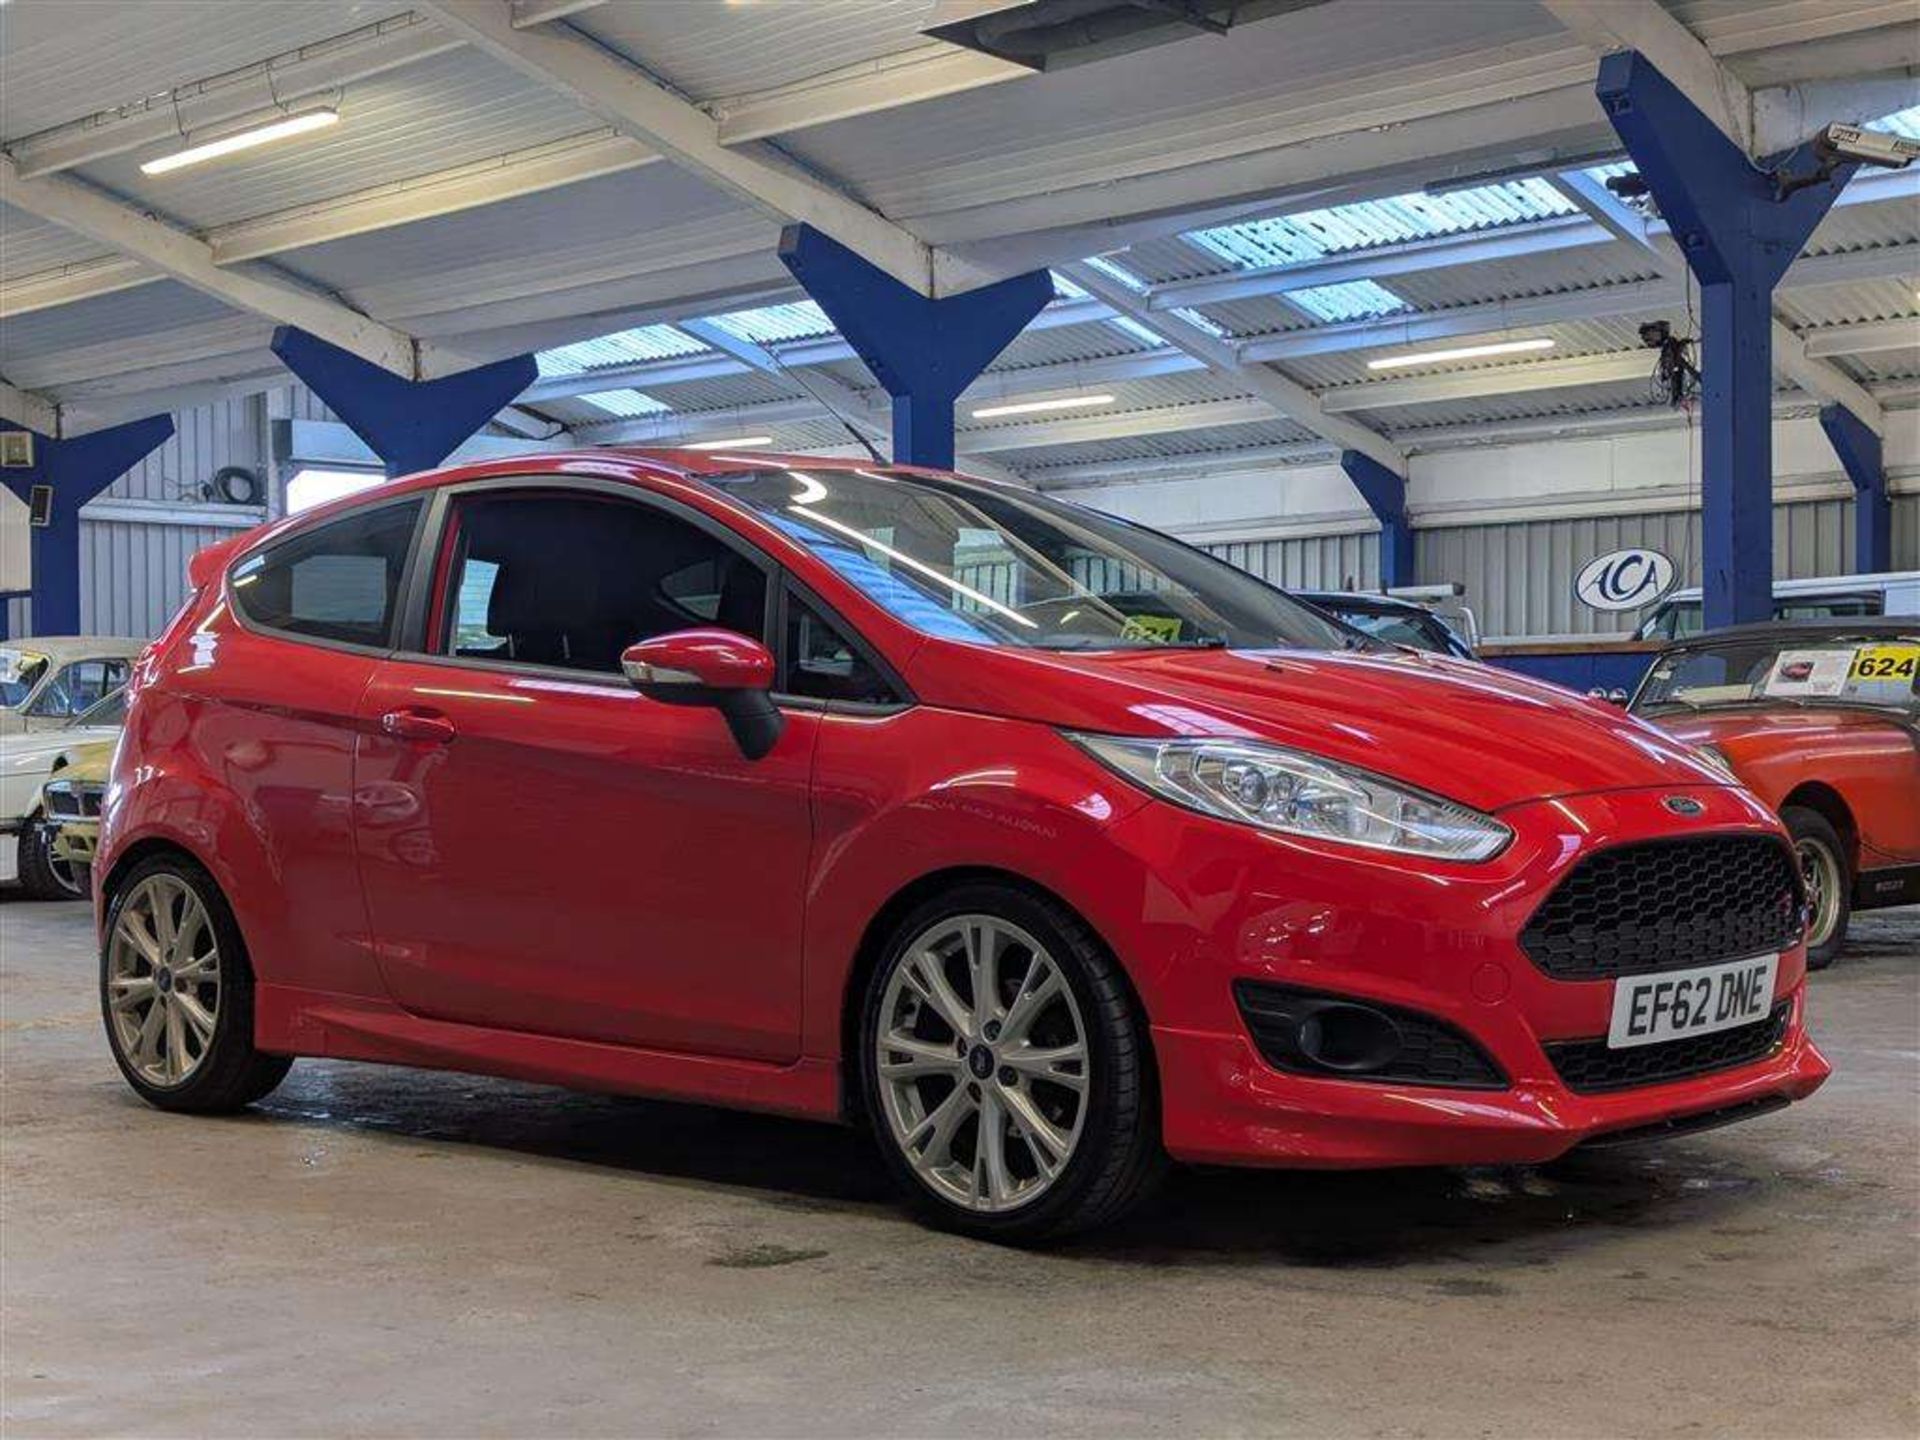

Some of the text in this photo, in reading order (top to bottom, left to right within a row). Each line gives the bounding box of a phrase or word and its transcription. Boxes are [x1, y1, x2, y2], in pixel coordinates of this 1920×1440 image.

[1581, 554, 1658, 601] ACA
[1858, 657, 1914, 677] 624
[1627, 965, 1767, 1036] EF62 DNE
